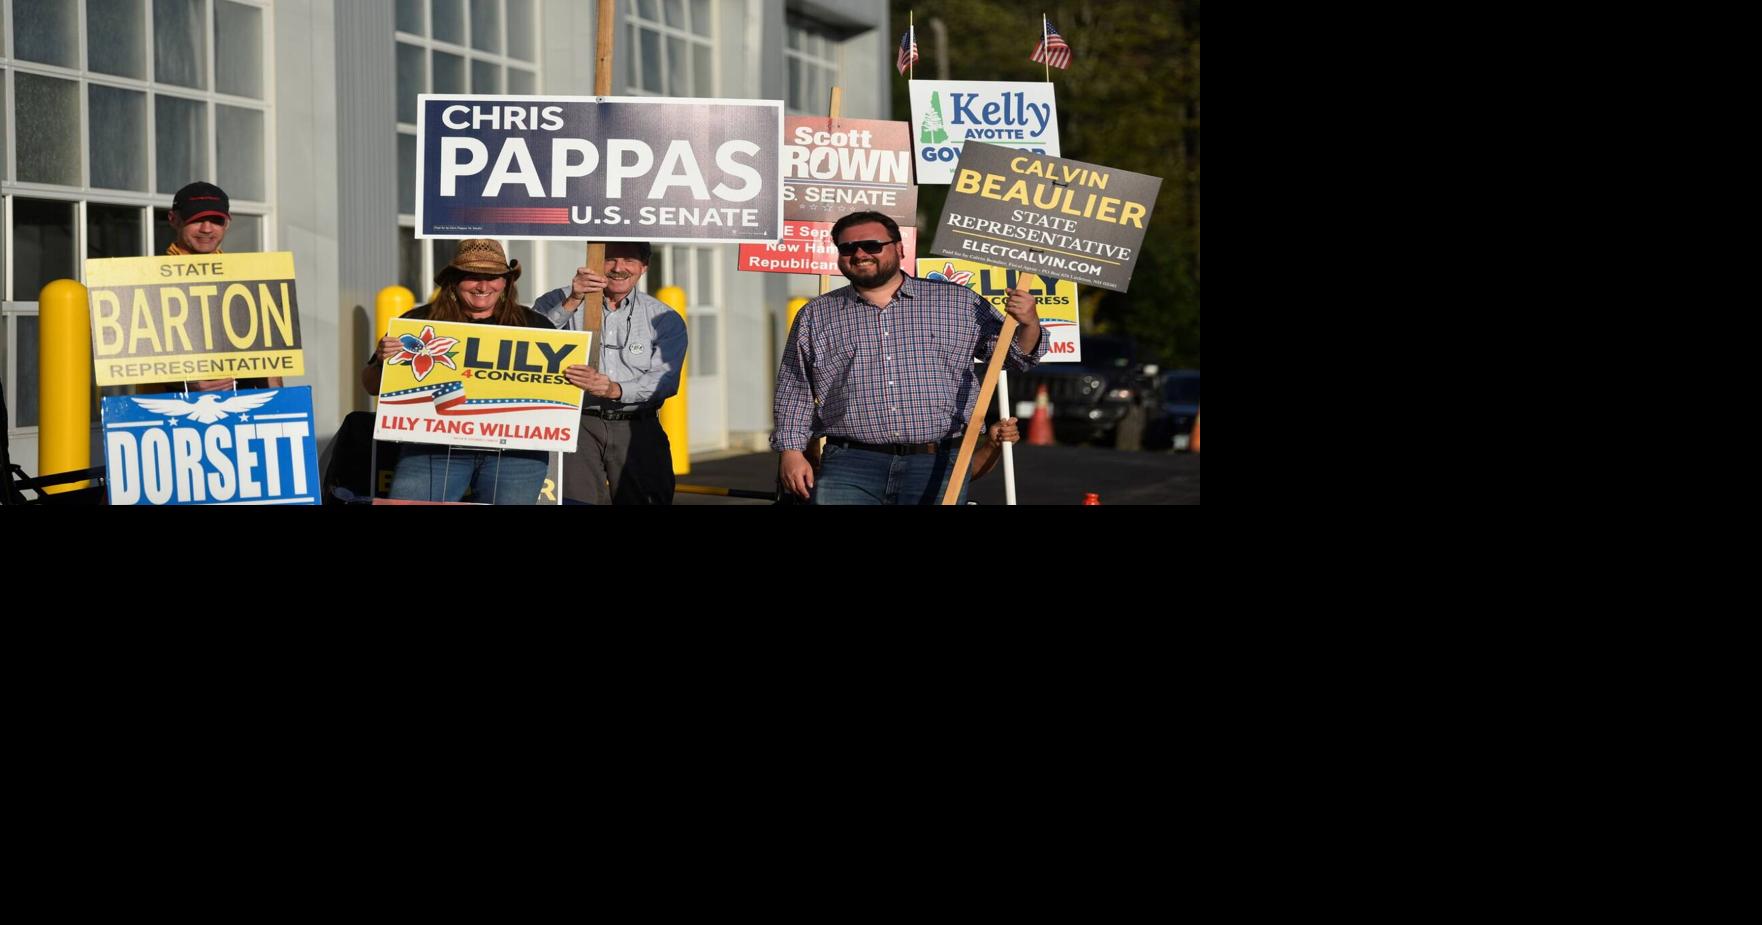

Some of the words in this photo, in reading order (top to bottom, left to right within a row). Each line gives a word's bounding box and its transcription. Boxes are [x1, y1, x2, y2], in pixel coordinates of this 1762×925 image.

[441, 105, 564, 131] CHRIS
[950, 91, 1051, 137] Kelly
[794, 126, 873, 148] Scott
[965, 128, 1025, 139] AYOTTE
[439, 136, 763, 203] PAPPAS
[784, 144, 910, 183] ROWN
[1010, 156, 1110, 190] CALVIN
[804, 186, 896, 206] SENATE
[955, 168, 1147, 229] BEAULIER
[571, 205, 630, 225] U.S.
[639, 206, 759, 227] SENATE
[1011, 208, 1078, 233] STATE
[766, 242, 800, 253] New
[947, 212, 1132, 261] REPRESENTATIVE
[160, 262, 224, 277] STATE
[962, 239, 1102, 276] ELECTCALVIN.COM
[91, 282, 294, 358] BARTON
[109, 356, 293, 378] REPRESENTATIVE
[463, 337, 578, 374] LILY
[381, 415, 420, 431] LILY
[423, 418, 474, 435] TANG
[480, 422, 571, 441] WILLIAMS
[106, 421, 309, 505] DORSETT
